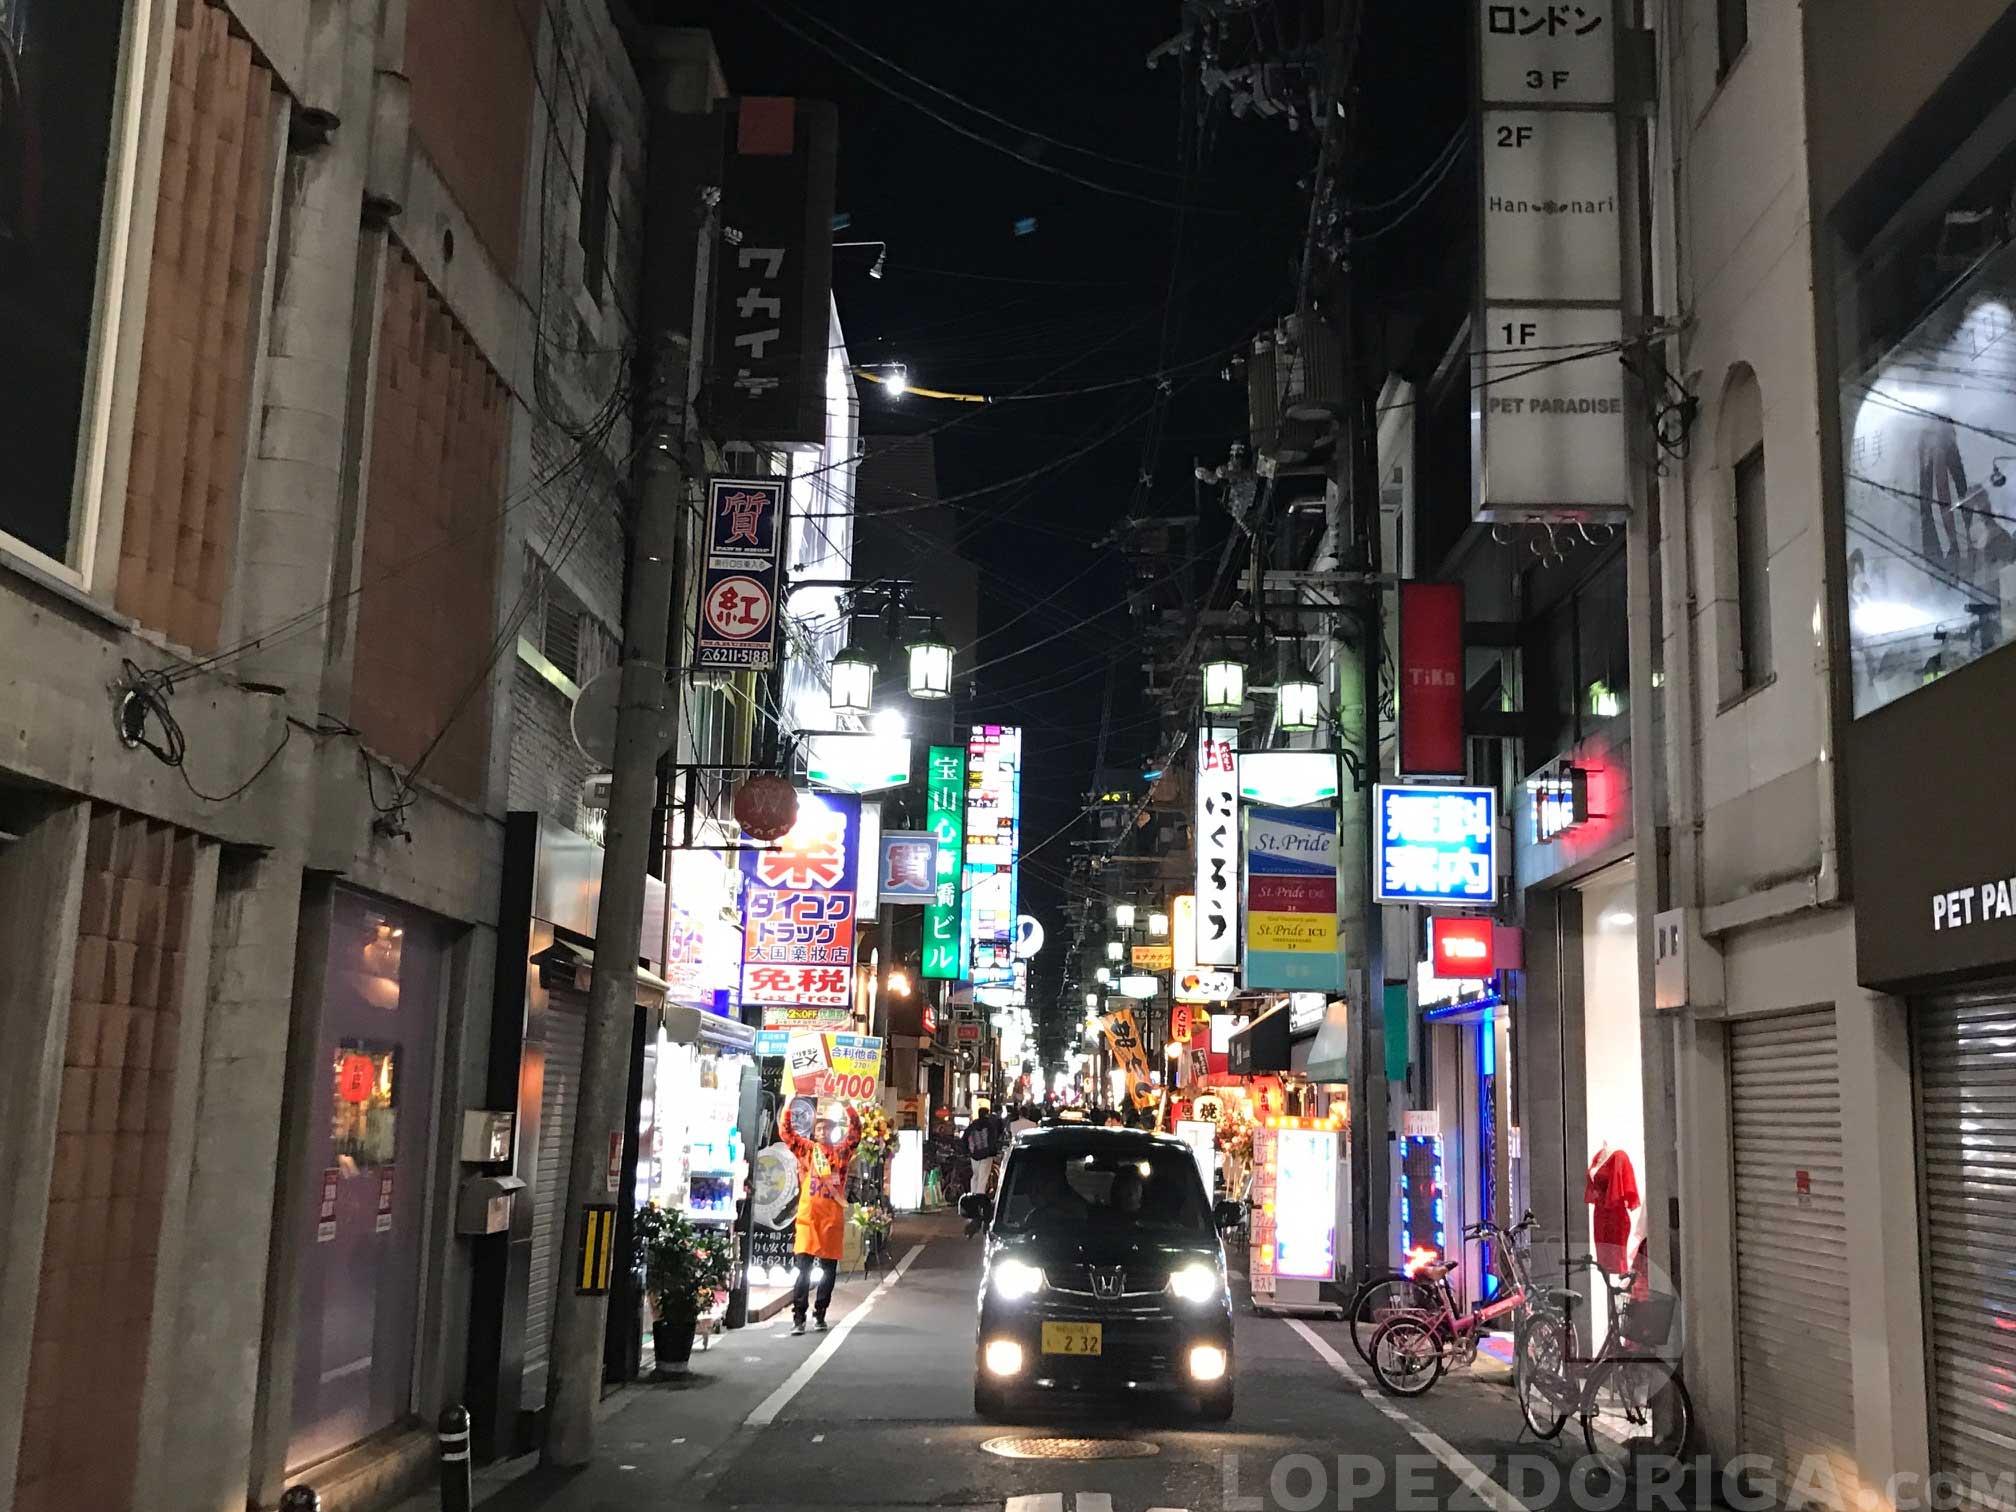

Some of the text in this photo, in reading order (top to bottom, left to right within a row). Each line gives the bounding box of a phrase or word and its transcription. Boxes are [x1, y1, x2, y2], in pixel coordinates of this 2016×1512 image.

[1488, 4, 1602, 36] ロンドン
[1526, 70, 1570, 90] 3F
[1496, 127, 1533, 148] 2F
[1502, 324, 1537, 346] 1F
[1488, 397, 1621, 414] PET PARADISE
[720, 491, 770, 546] 質
[716, 585, 761, 627] 紅
[1408, 668, 1456, 687] TiKa
[750, 893, 851, 921] ダイコク
[1932, 878, 2016, 931] PET PA
[758, 922, 837, 944] ドラッグ
[749, 967, 846, 993] 免税
[795, 992, 842, 1004] Free
[791, 1053, 819, 1070] EX
[832, 1046, 878, 1061] 合利他命
[823, 1072, 876, 1099] 4700
